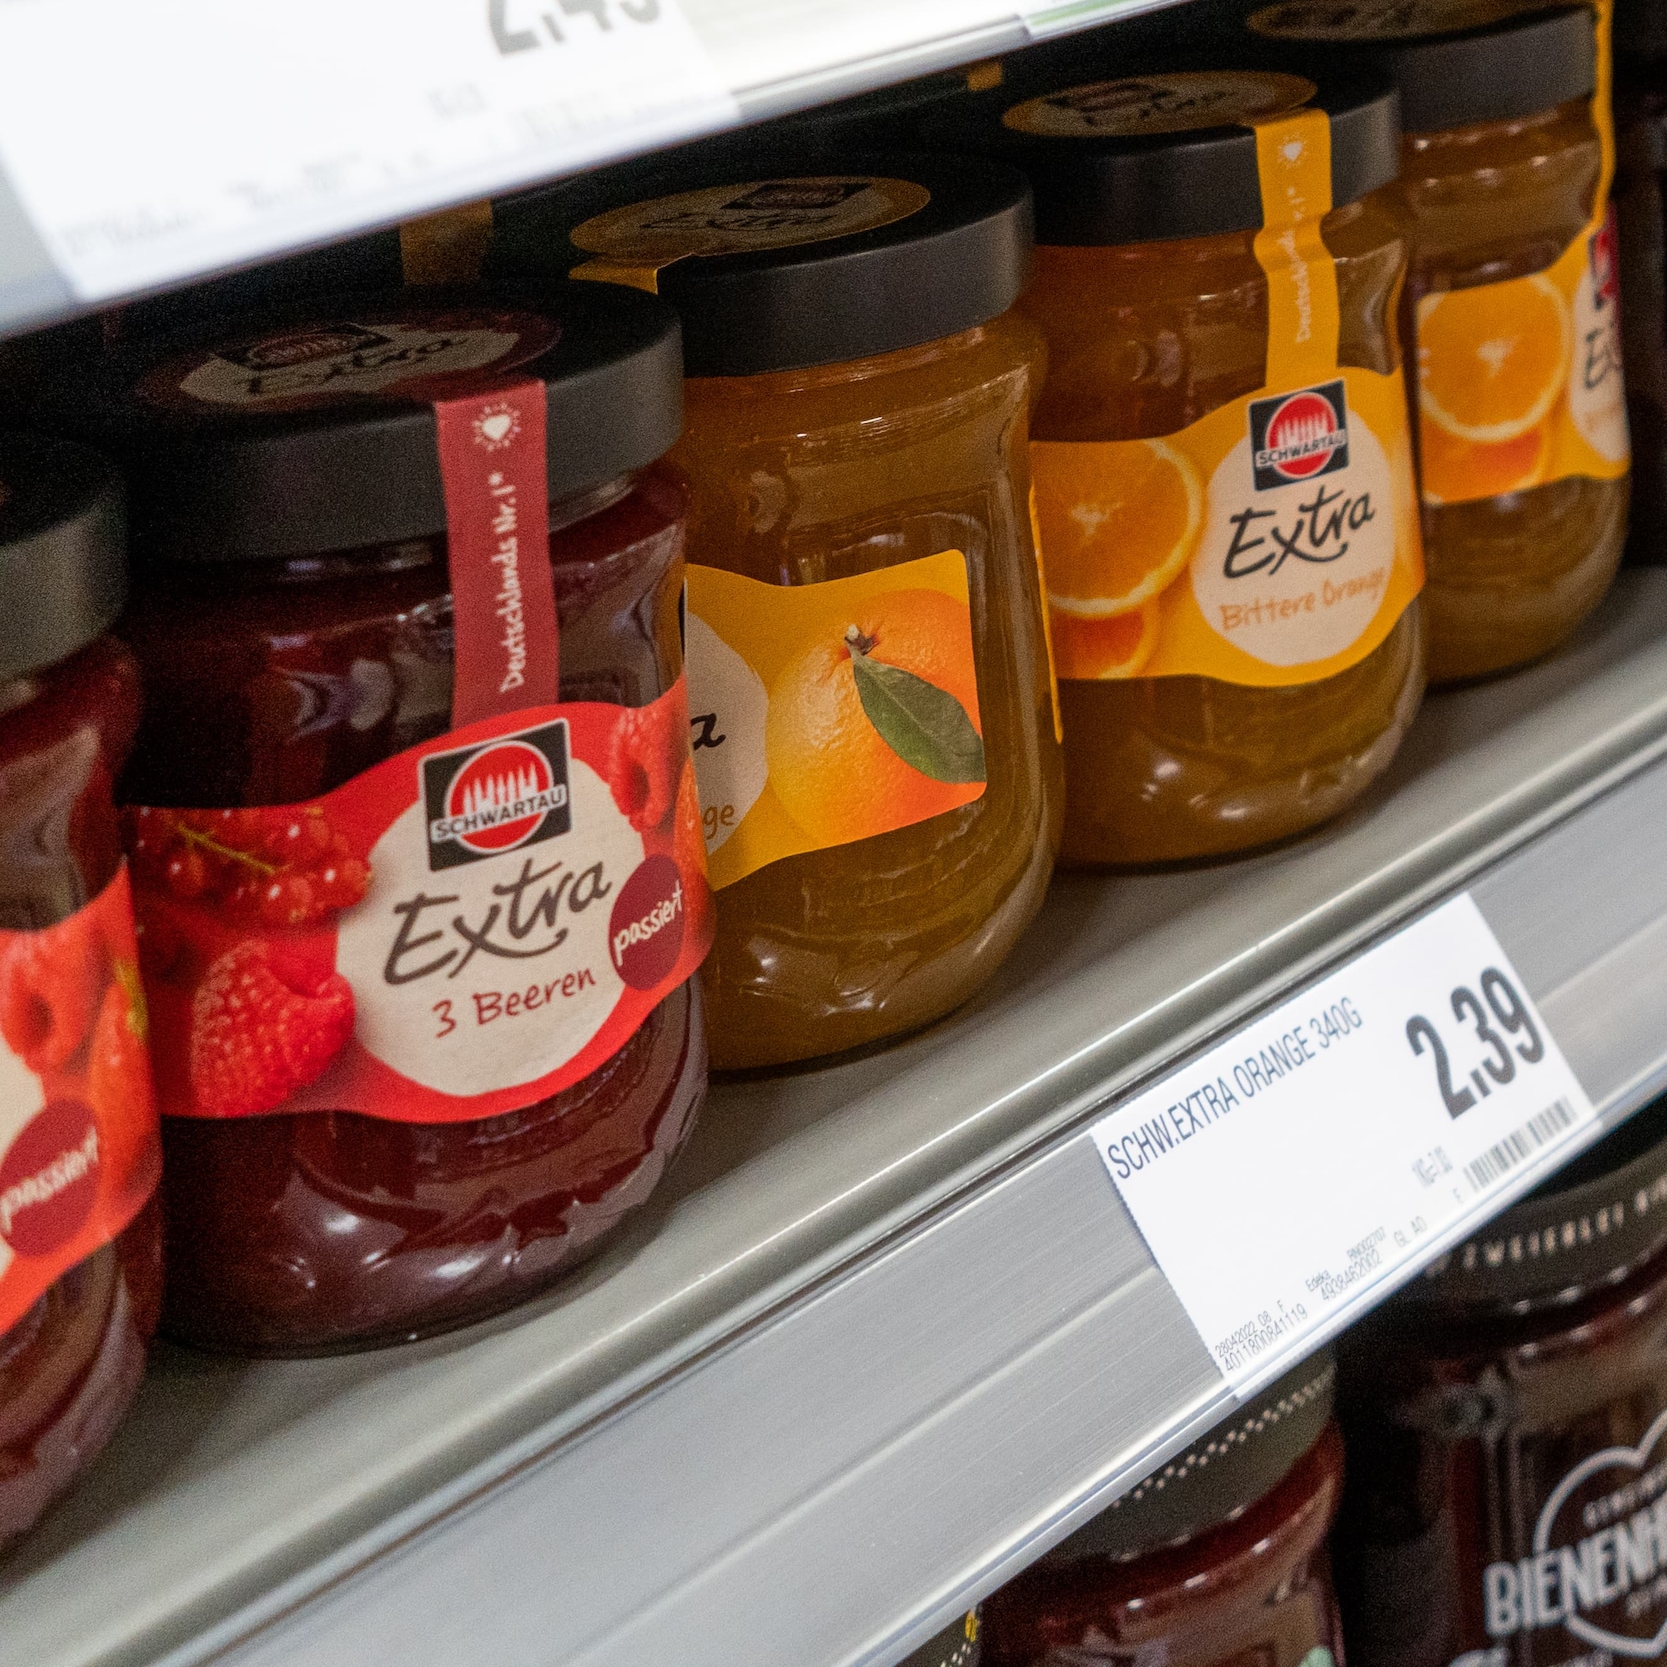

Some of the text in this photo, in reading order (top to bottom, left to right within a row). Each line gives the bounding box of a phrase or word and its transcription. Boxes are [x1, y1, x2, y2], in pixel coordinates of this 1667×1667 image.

[1257, 428, 1346, 468] SCHWARTAU
[1223, 484, 1377, 580] Extra
[497, 522, 525, 694] Deutschlands
[1220, 565, 1388, 633] Bittere Orange
[431, 786, 567, 841] SCHWARTAU
[382, 858, 613, 986] Extra
[612, 881, 685, 967] passiert
[431, 965, 597, 1038] 3 Beeren
[1404, 965, 1546, 1121] 2.39
[1107, 995, 1363, 1181] SCHW.EXTRA ORANGE 340G
[1305, 1269, 1331, 1293] Edeka
[1224, 1302, 1310, 1374] 4011800841119
